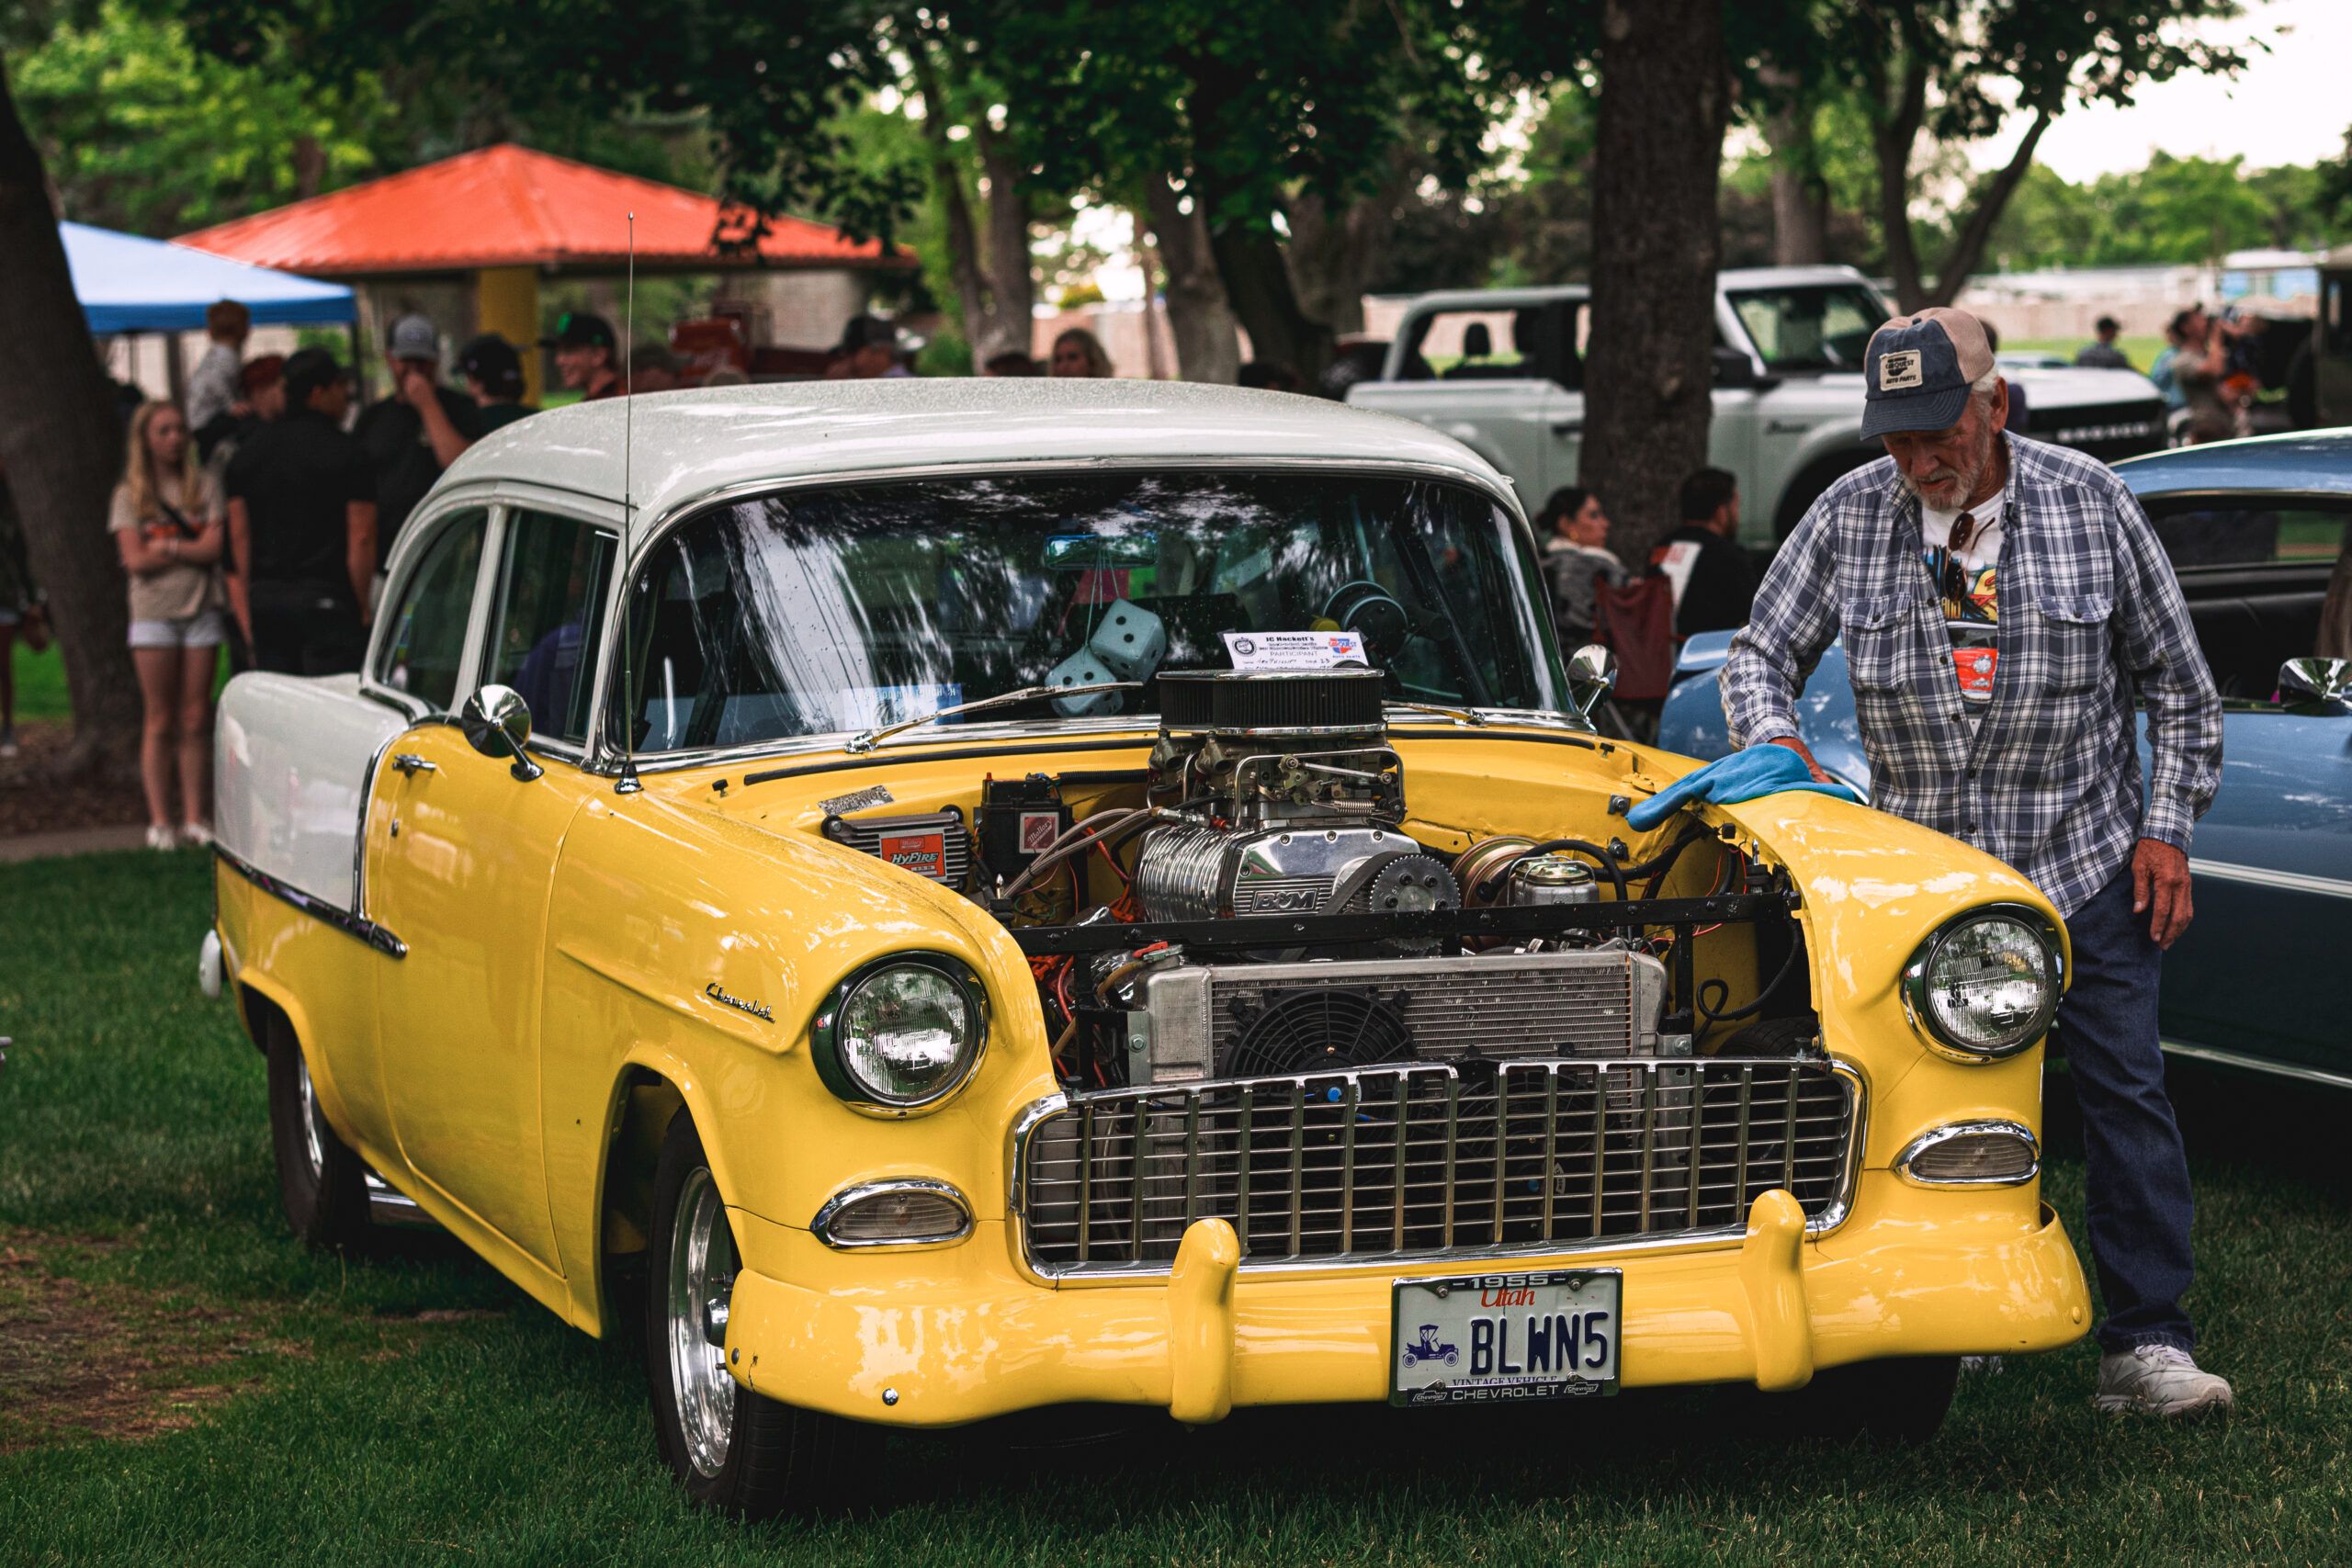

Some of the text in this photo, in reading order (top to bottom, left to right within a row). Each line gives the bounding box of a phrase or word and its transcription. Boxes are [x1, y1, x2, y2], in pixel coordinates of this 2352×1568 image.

[1255, 891, 1316, 909] B&M
[1480, 1287, 1535, 1308] Utah
[1470, 1311, 1609, 1375] BLWN5
[1453, 1377, 1505, 1387] VINTAGE
[1453, 1384, 1559, 1401] CHEVROLET
